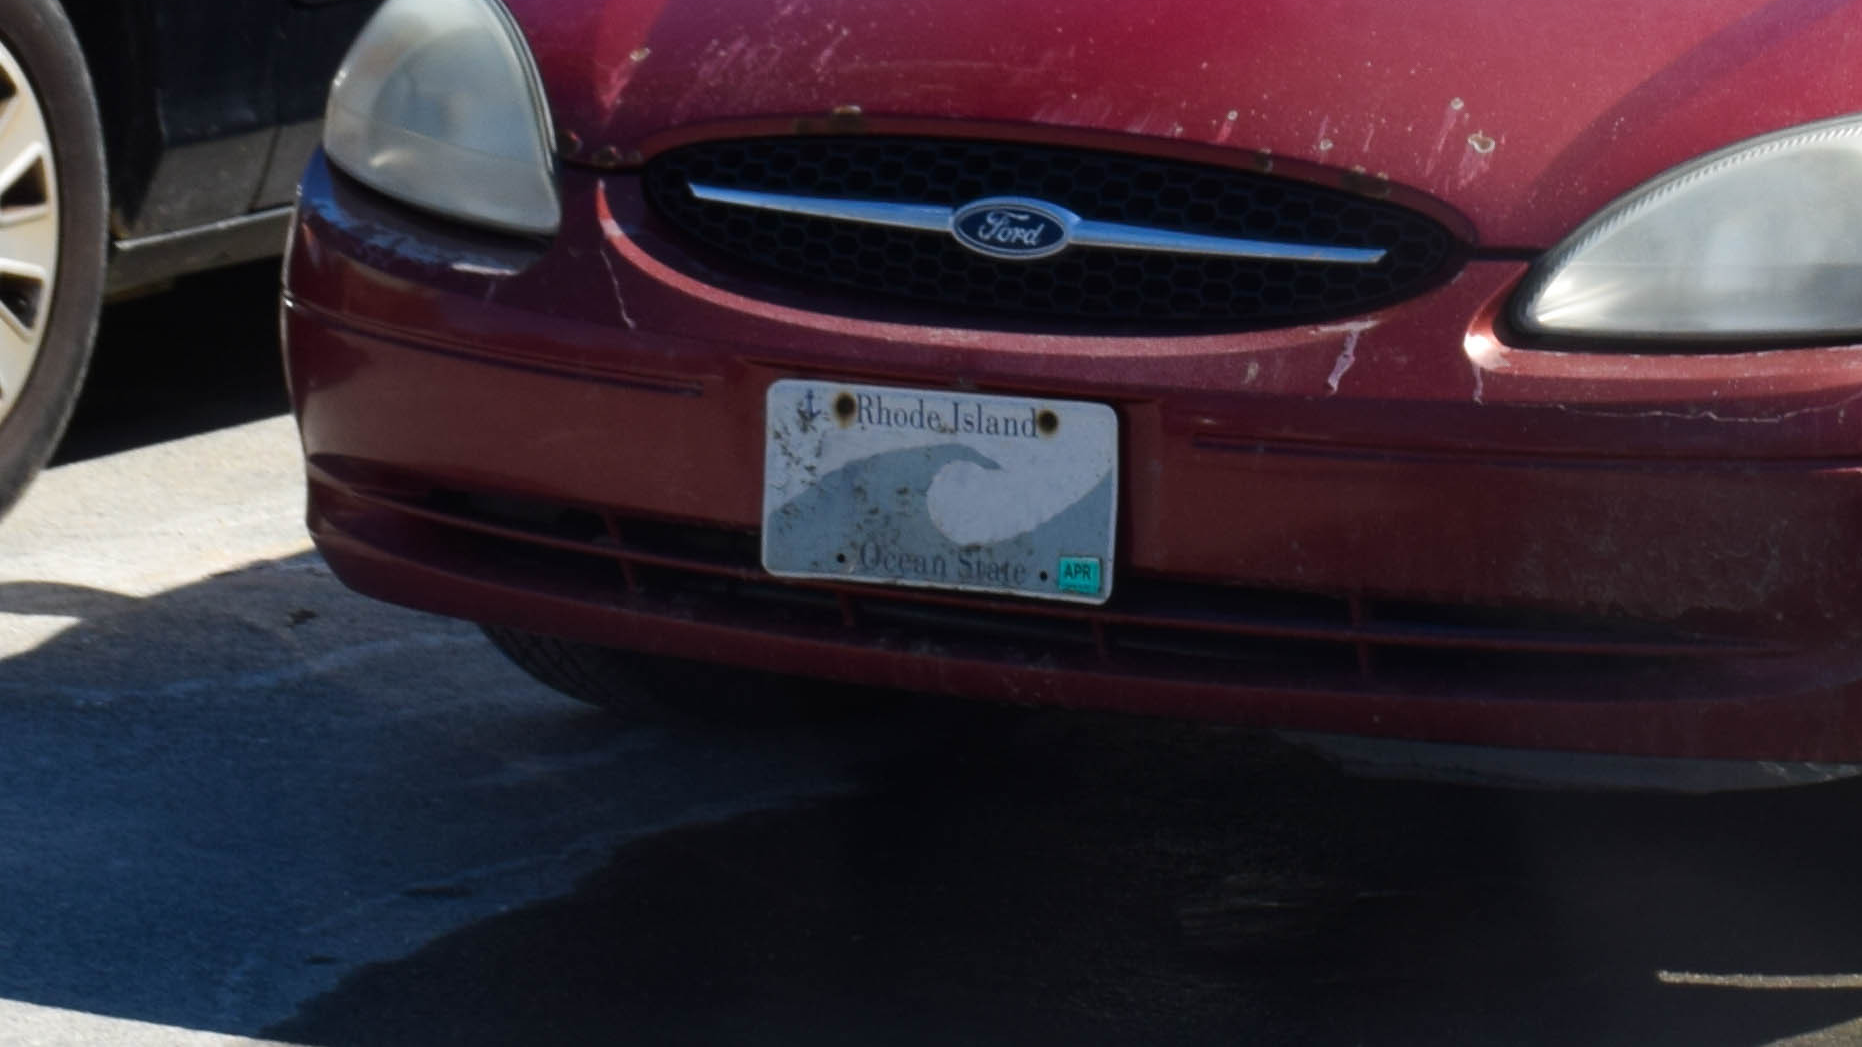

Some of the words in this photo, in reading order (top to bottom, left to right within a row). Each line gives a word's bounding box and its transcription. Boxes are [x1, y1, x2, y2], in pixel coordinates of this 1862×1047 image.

[978, 210, 1044, 245] Ford
[857, 392, 941, 430] Rhode
[951, 402, 1038, 438] Island
[860, 539, 947, 579] Ocean
[957, 551, 1026, 587] State
[1064, 562, 1092, 580] APR
